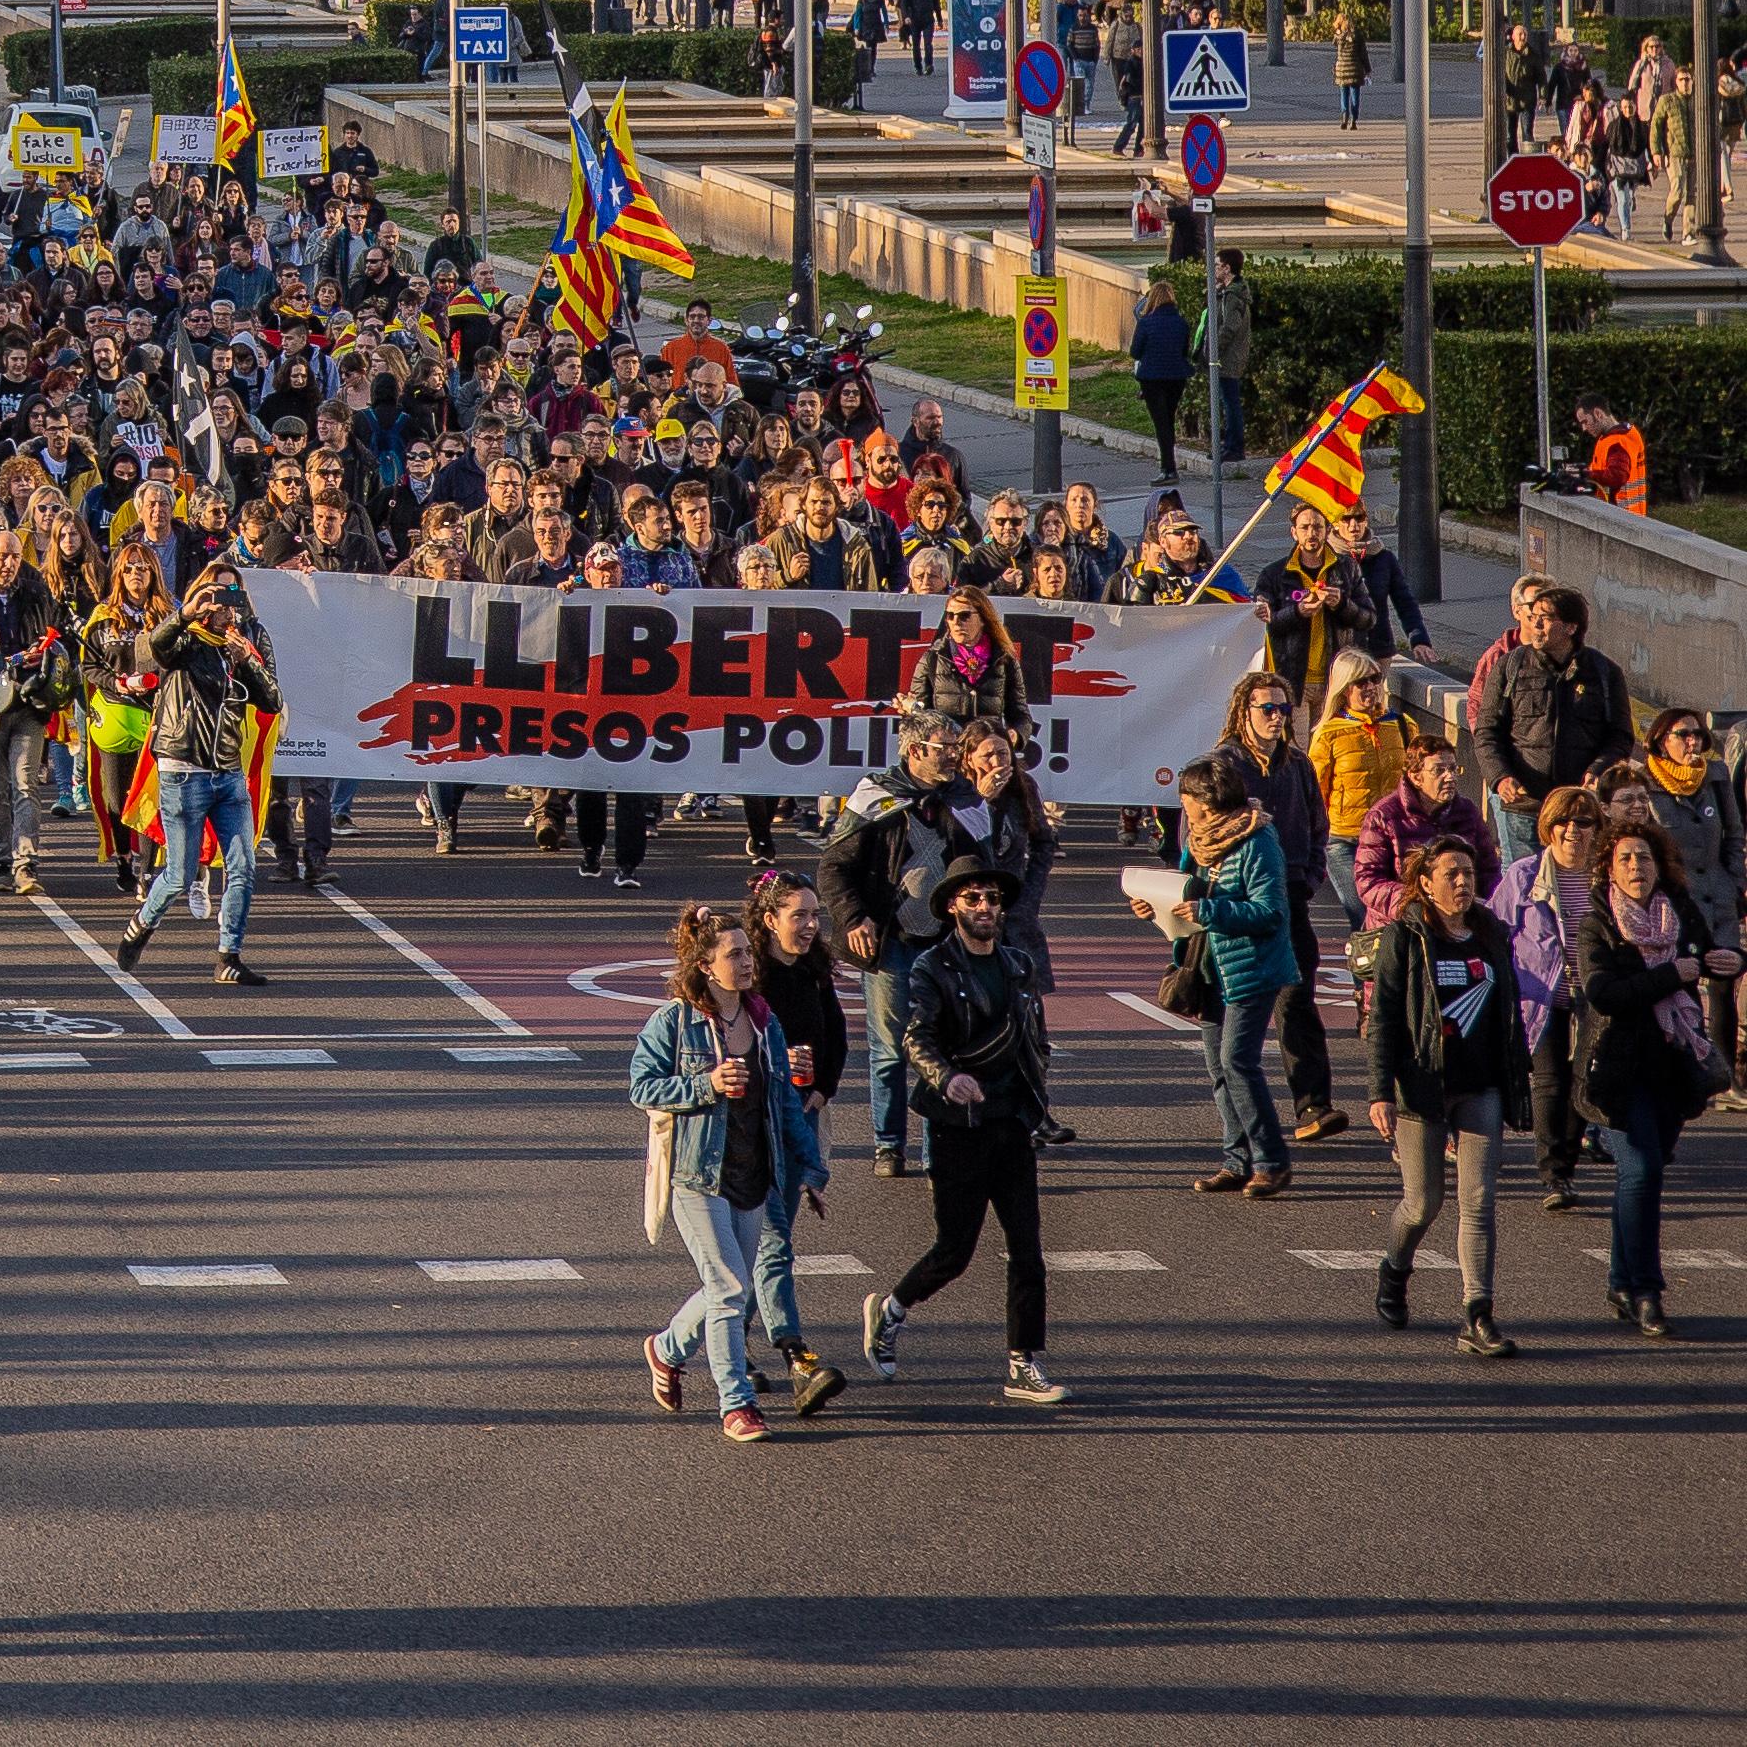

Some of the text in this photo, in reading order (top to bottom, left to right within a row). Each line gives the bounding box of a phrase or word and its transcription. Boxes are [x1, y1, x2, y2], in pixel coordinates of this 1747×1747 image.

[460, 40, 503, 55] TAXI
[22, 135, 65, 150] fake
[265, 130, 325, 143] freedom?
[286, 144, 300, 152] or
[21, 152, 73, 165] Justice
[159, 151, 214, 163] democracy
[1499, 189, 1574, 211] STOP
[411, 595, 1075, 706] LLIBERTT
[411, 700, 691, 763] PRESOS
[298, 741, 315, 750] per
[316, 739, 327, 748] la
[275, 748, 327, 758] emocràcia
